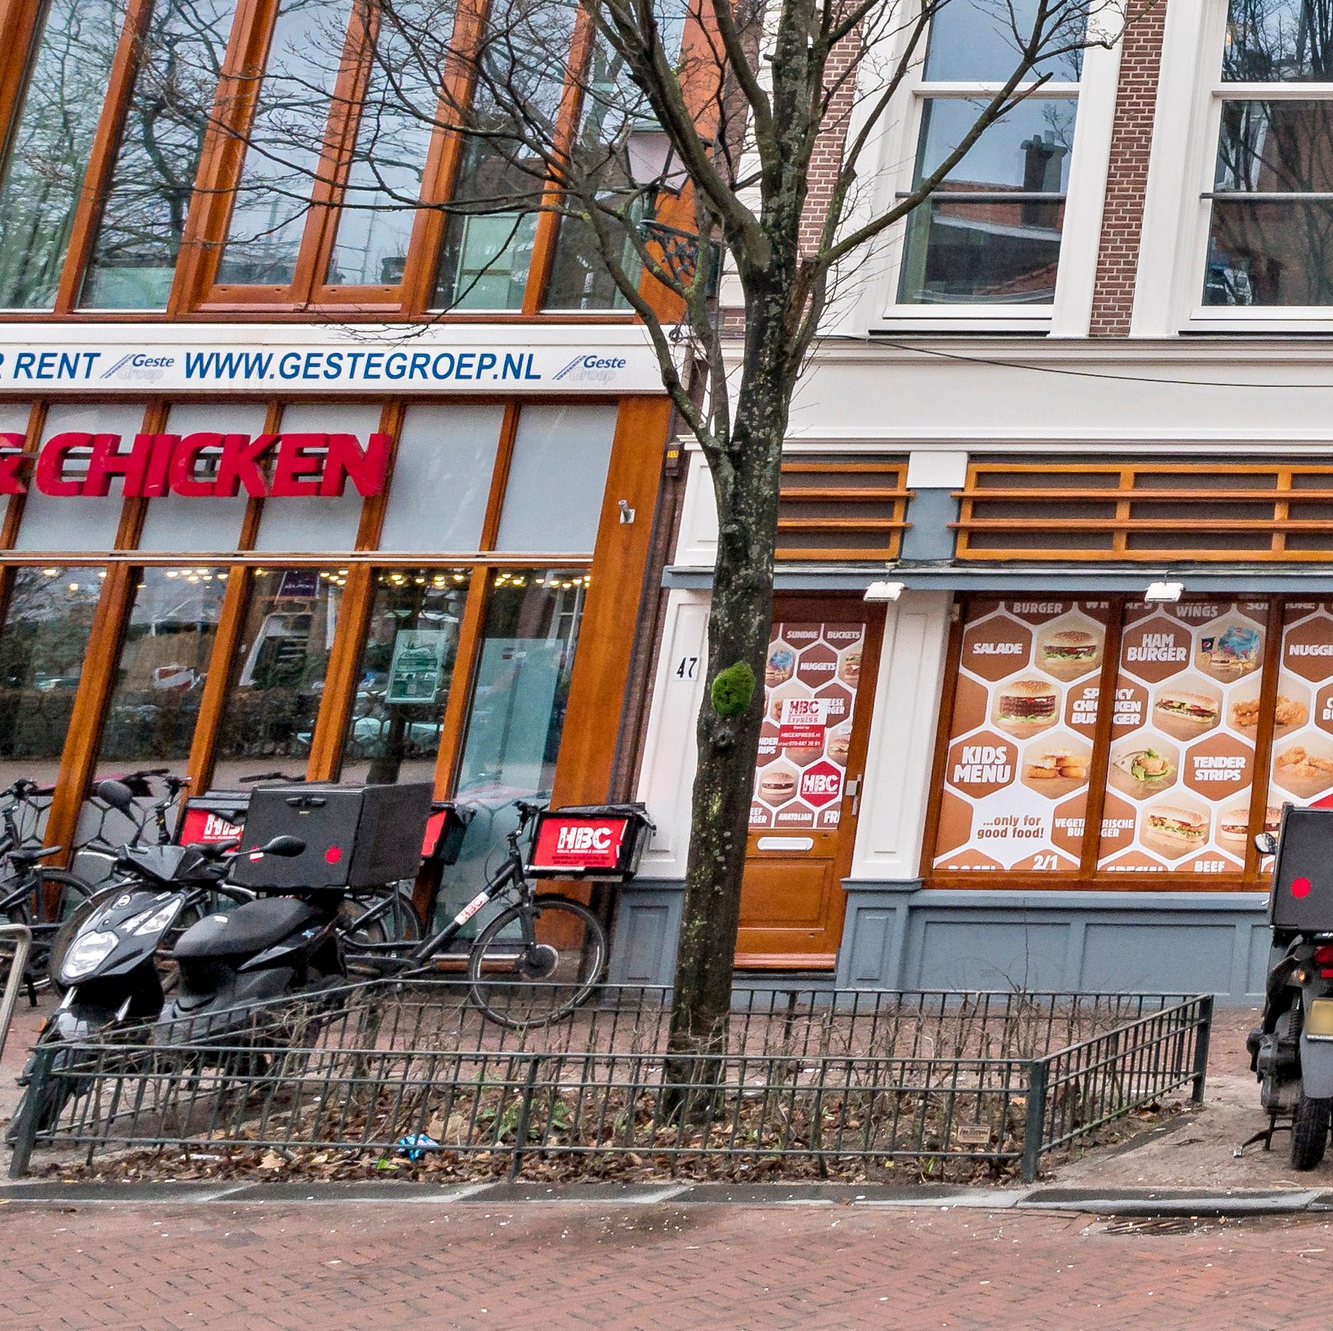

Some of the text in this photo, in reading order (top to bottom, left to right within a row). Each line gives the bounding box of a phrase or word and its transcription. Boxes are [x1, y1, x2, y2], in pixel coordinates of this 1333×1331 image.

[13, 353, 101, 379] RENT
[132, 354, 175, 368] Geste
[185, 352, 541, 380] WWW.GESTEGROEP.NL
[583, 355, 626, 369] Geste
[36, 432, 393, 497] CHICKEN
[1013, 602, 1062, 613] BURGER
[1176, 606, 1218, 617] WINGS
[787, 631, 818, 639] SUNDAE
[827, 631, 860, 639] BUCKETS
[1142, 634, 1174, 647] HAM
[973, 643, 1023, 654] SALADE
[1127, 647, 1187, 661] BURGER
[676, 657, 697, 678] 47
[800, 663, 836, 671] NUGGETS
[788, 701, 819, 714] HBC
[962, 746, 1006, 764] KIDS
[1193, 756, 1246, 768] TENDER
[953, 764, 1010, 783] MENU
[1194, 769, 1241, 781] STRIPS
[802, 775, 839, 791] HBC
[1023, 815, 1042, 825] for
[557, 827, 613, 849] HBC
[977, 827, 1044, 839] good food!
[1194, 861, 1226, 872] BEEF
